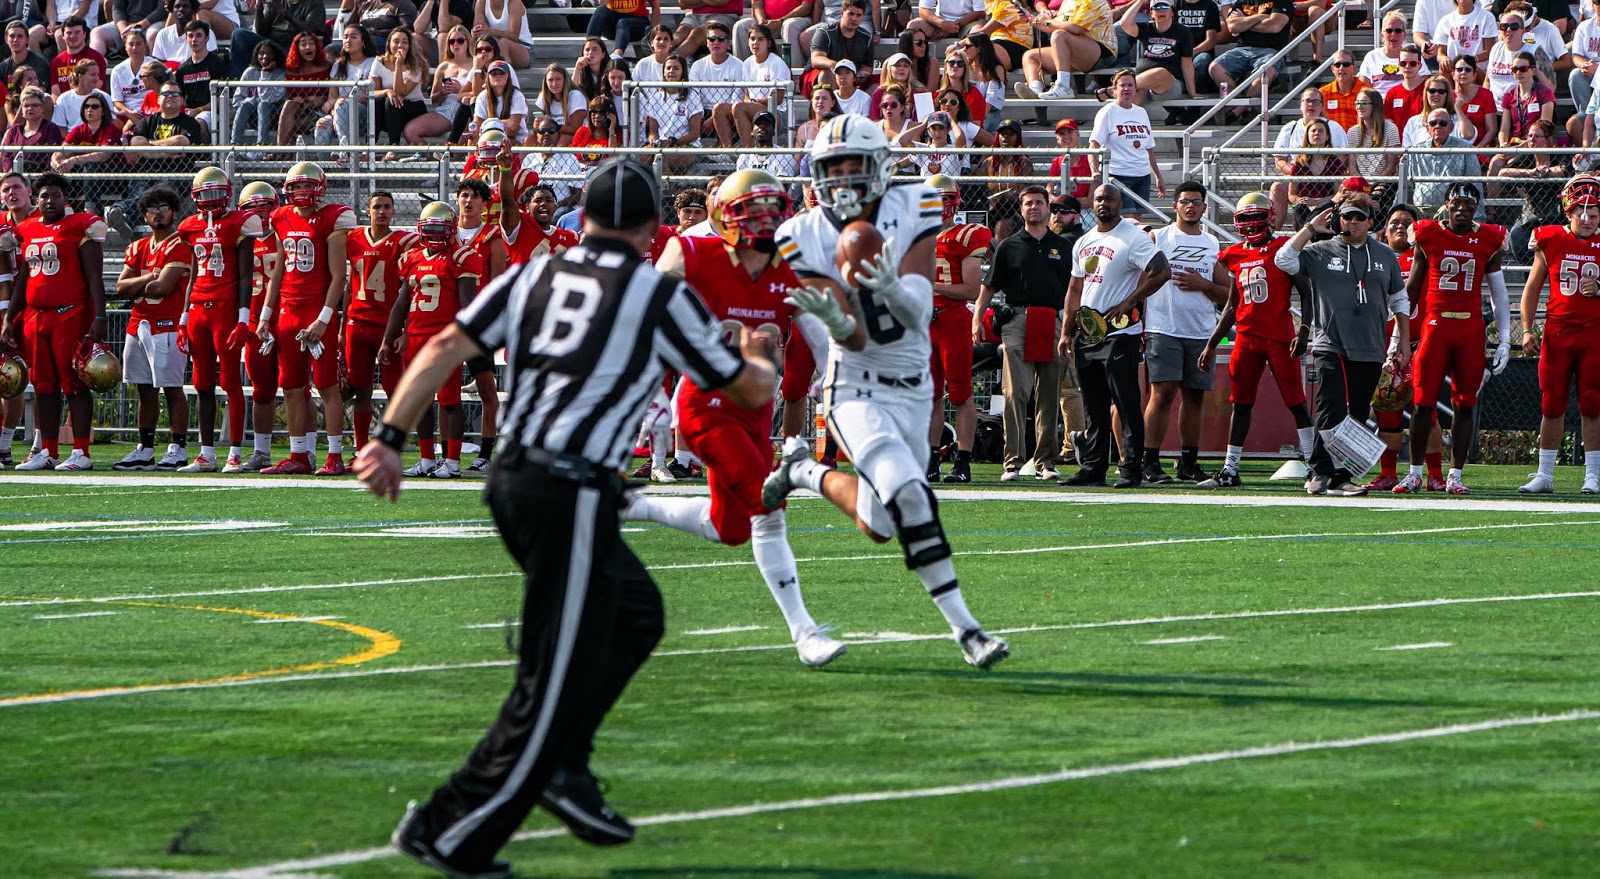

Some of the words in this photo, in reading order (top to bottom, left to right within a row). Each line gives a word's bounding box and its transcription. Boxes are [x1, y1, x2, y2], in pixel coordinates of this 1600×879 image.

[1178, 17, 1205, 25] CREW
[1116, 124, 1151, 136] KING'S
[25, 242, 61, 278] 68
[193, 243, 225, 277] 24
[283, 237, 315, 273] 39
[1443, 250, 1474, 258] MONARCHS
[1565, 253, 1596, 261] MONARCHS
[355, 257, 386, 302] 14
[1239, 266, 1268, 305] 16
[1438, 256, 1476, 291] 21
[528, 270, 604, 357] B
[726, 306, 777, 320] MONARCHS
